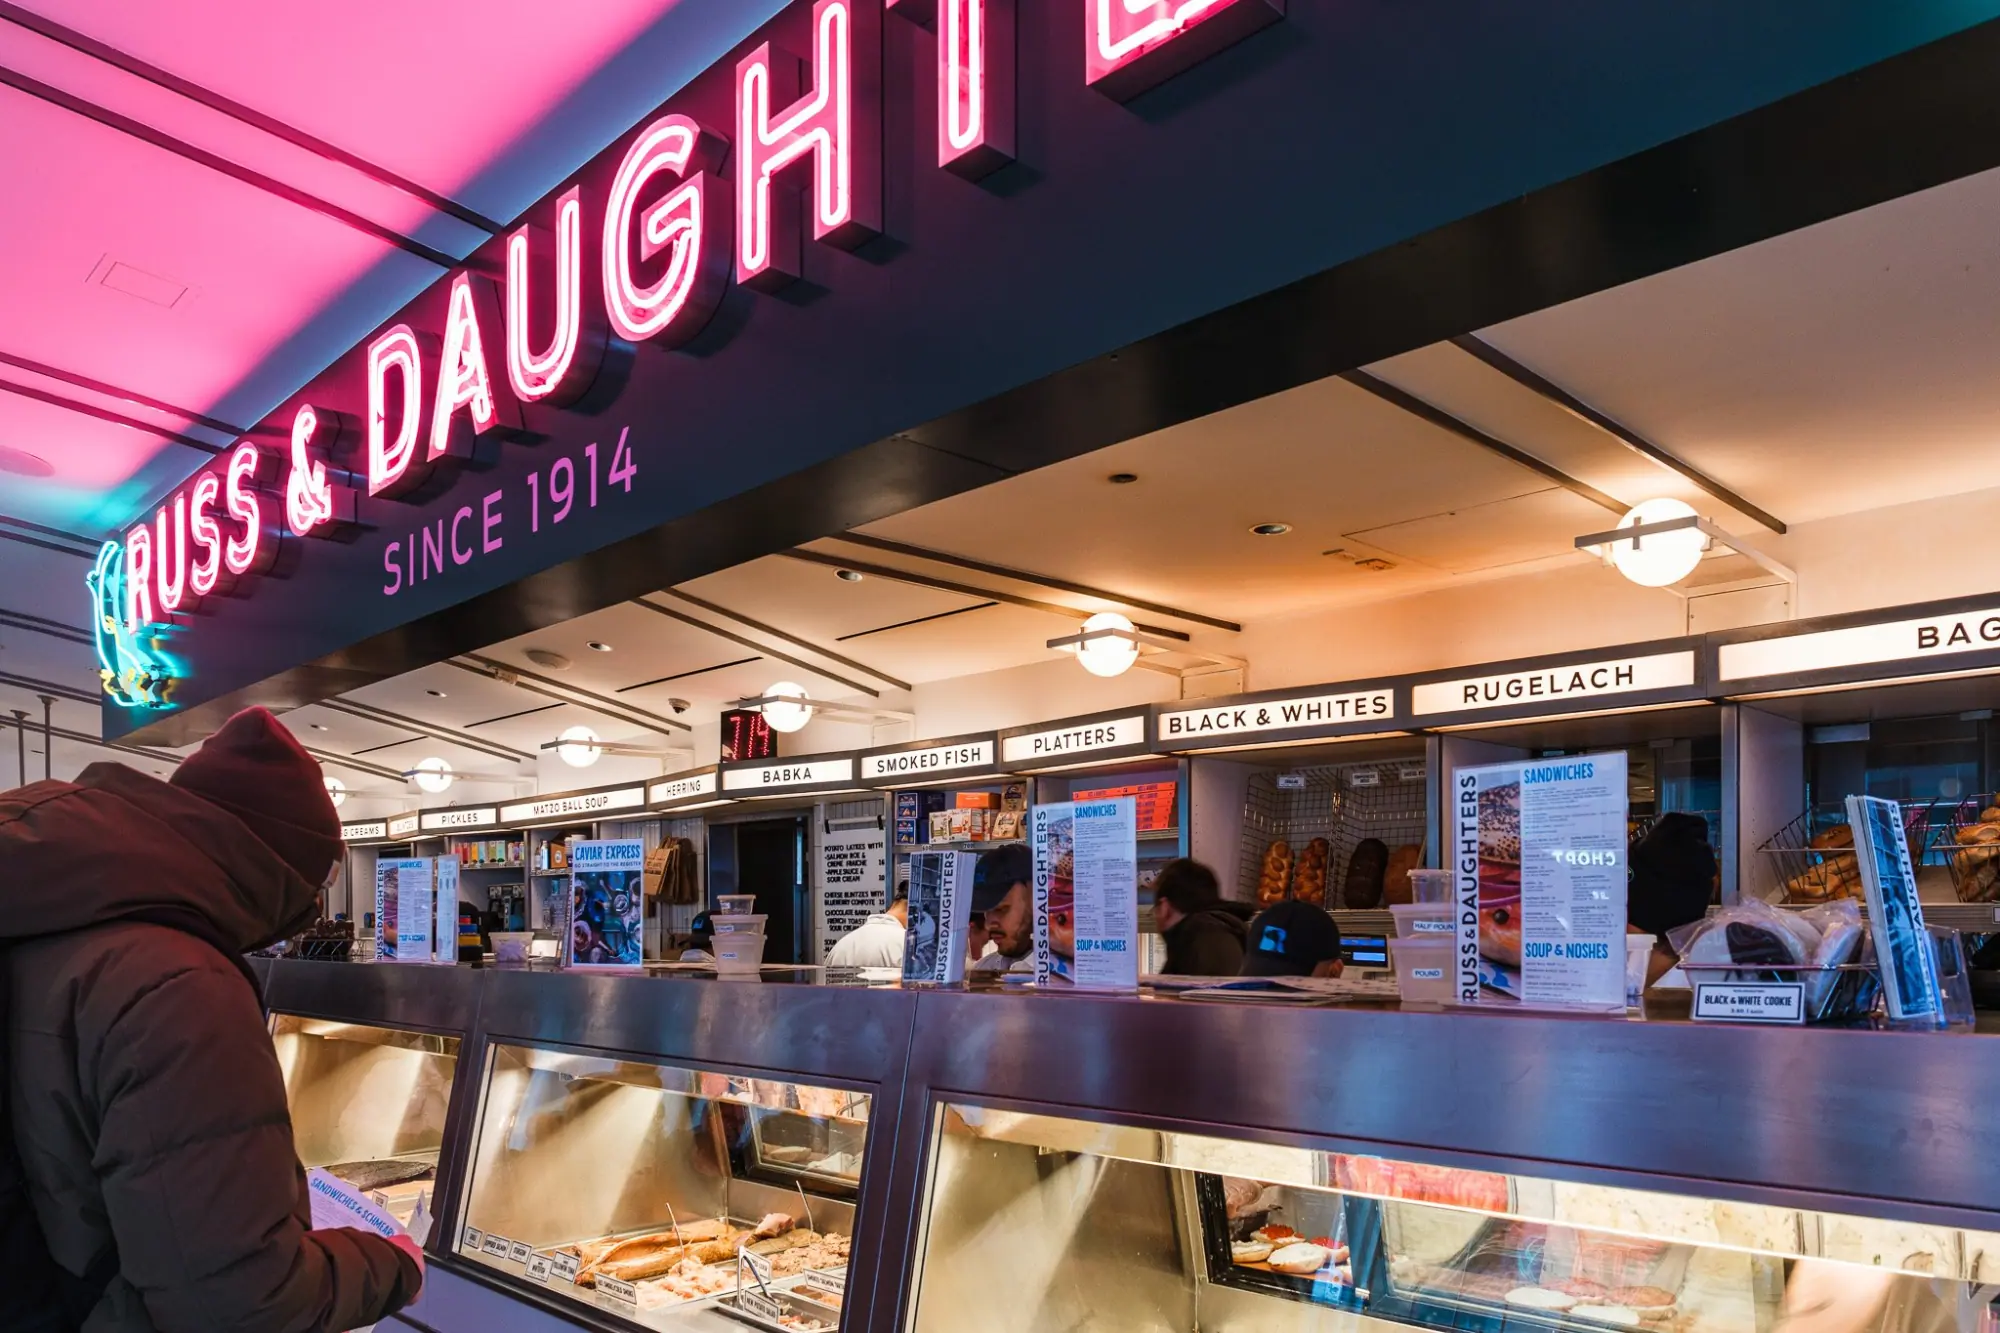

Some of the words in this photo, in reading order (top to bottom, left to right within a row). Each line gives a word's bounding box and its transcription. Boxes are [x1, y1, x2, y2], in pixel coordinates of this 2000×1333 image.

[127, 441, 259, 634] RUSS
[287, 404, 331, 536] &
[383, 489, 502, 595] SINCE
[527, 425, 637, 533] 1914
[1463, 664, 1634, 704] RUGELACH
[1169, 711, 1247, 734] BLACK
[1256, 708, 1271, 725] &
[1282, 695, 1387, 722] WHITES
[1034, 726, 1116, 753] PLATTERS
[877, 752, 938, 773] SMOKED
[945, 747, 981, 765] FISH
[763, 767, 812, 783] BABKA
[1524, 763, 1593, 784] SANDWICHES
[666, 780, 701, 796] HERRING
[533, 804, 559, 816] MATZO
[562, 801, 582, 813] BALL
[585, 796, 608, 808] SOUP
[1075, 803, 1117, 818] SANDWICHES
[442, 813, 478, 824] PICKLES
[351, 826, 379, 836] CREAMS
[575, 846, 602, 860] CAVIAR
[606, 845, 640, 860] EXPRESS
[1076, 939, 1093, 951] SOUP
[1094, 940, 1100, 950] &
[1101, 939, 1126, 952] NOSHES
[1525, 943, 1553, 958] SOUP
[1555, 944, 1564, 956] &
[1566, 943, 1608, 959] NOSHES
[1704, 995, 1729, 1005] BLACK
[1730, 996, 1736, 1005] &
[1738, 996, 1761, 1005] WHITE
[1764, 996, 1792, 1006] COOKIE
[311, 1178, 356, 1211] SANDWICHES
